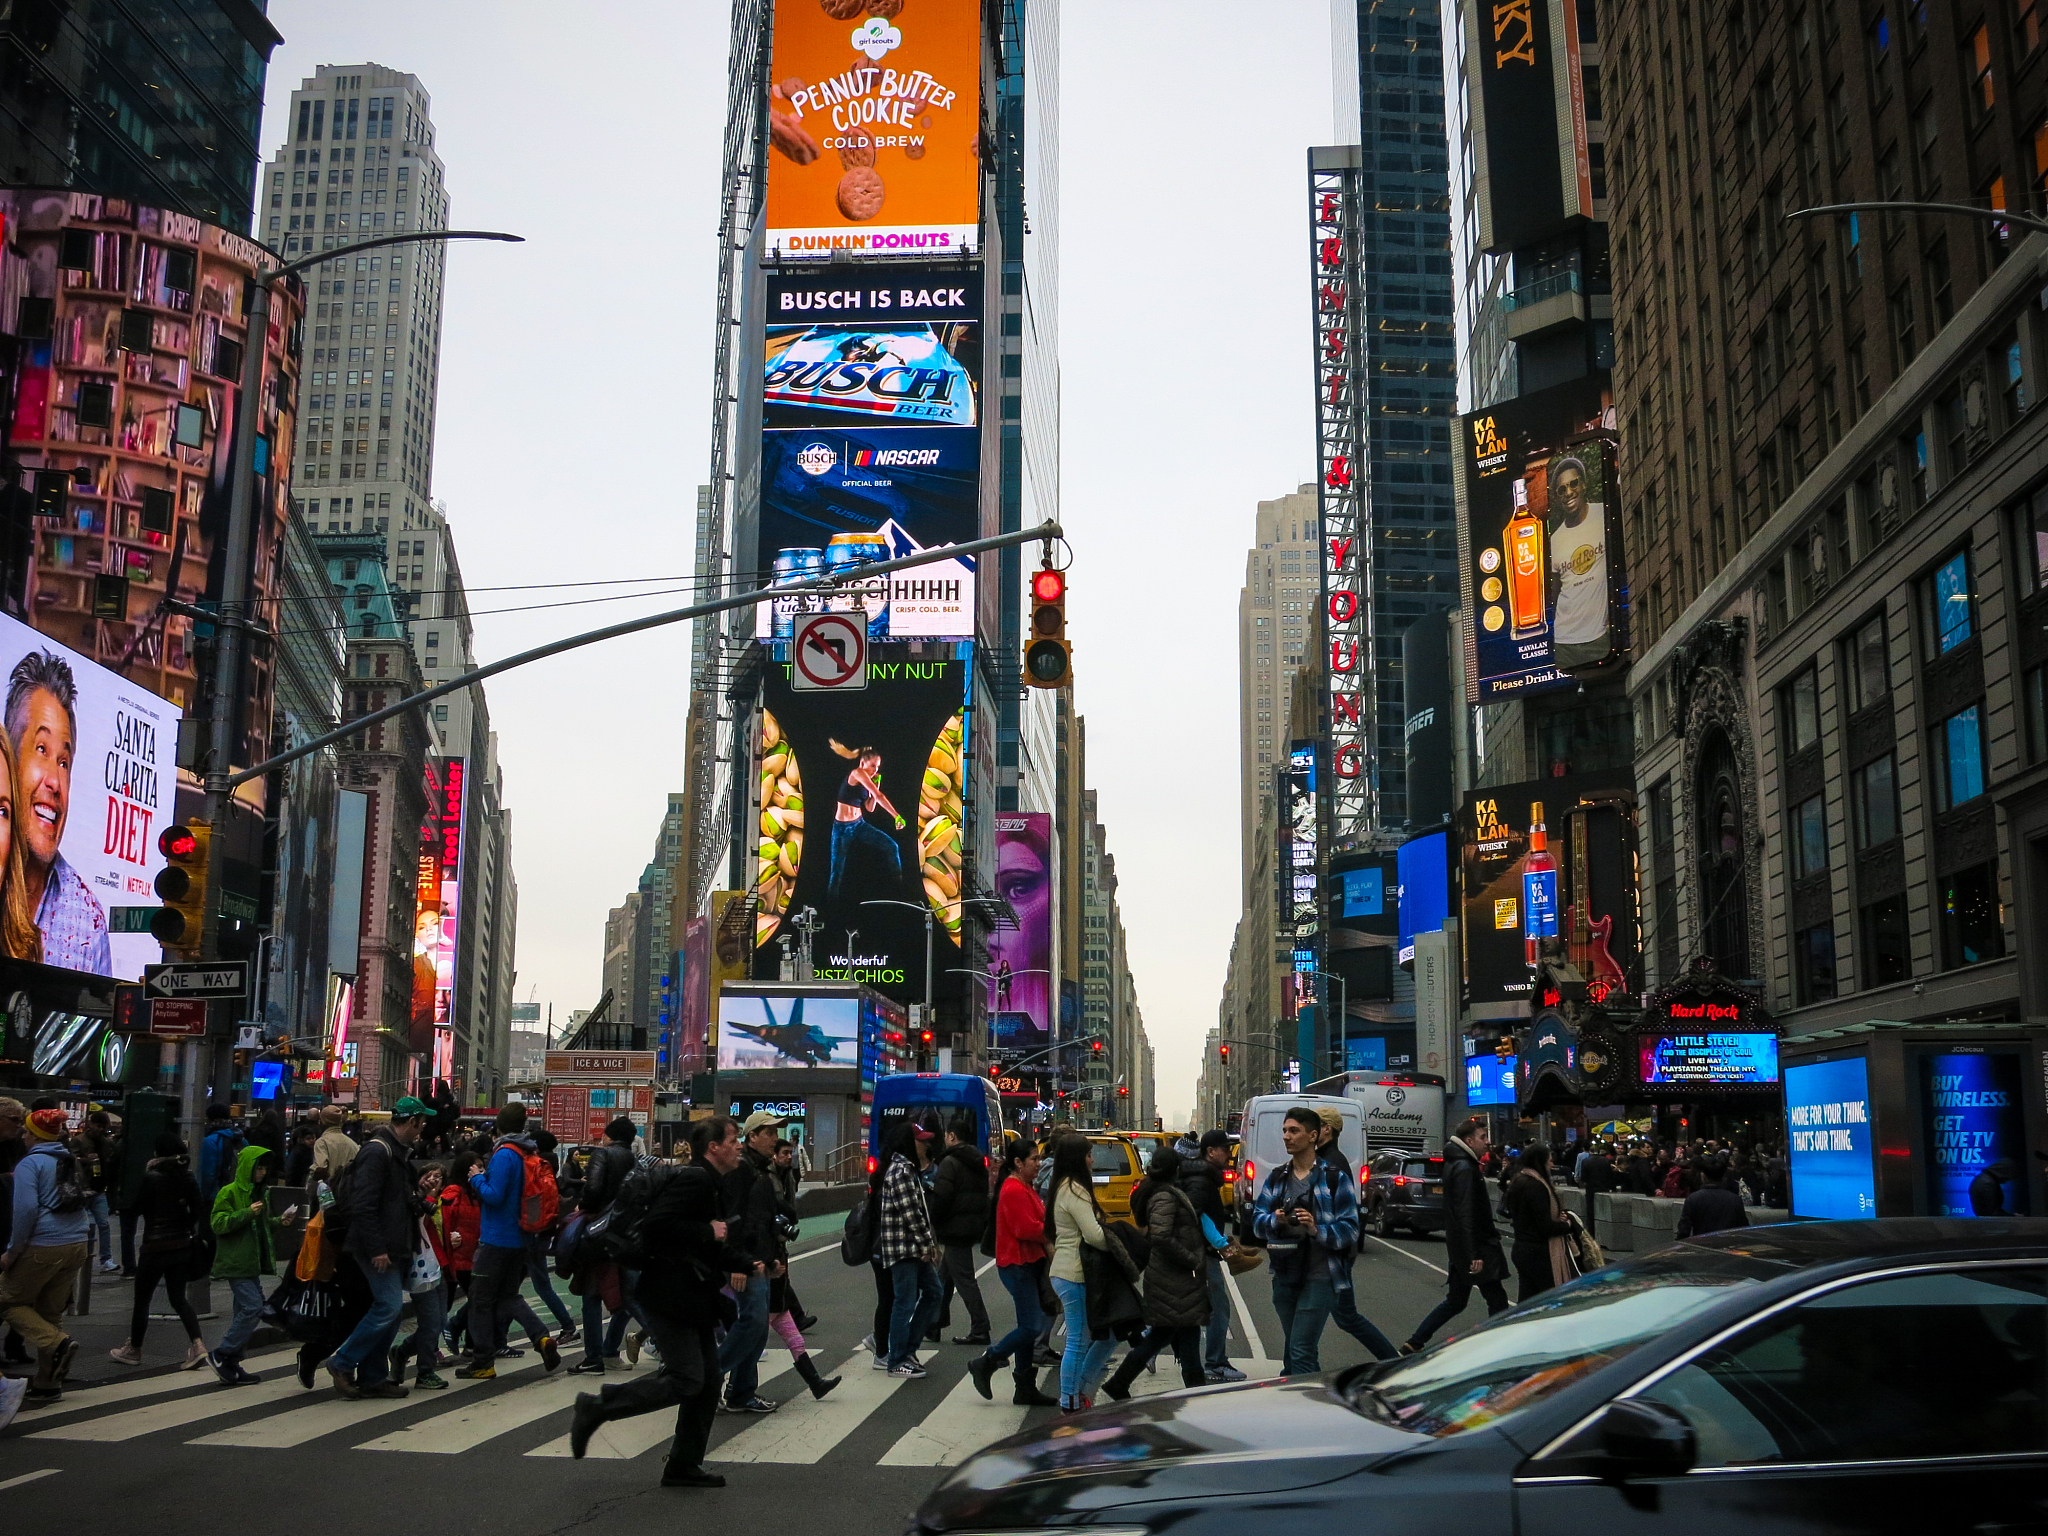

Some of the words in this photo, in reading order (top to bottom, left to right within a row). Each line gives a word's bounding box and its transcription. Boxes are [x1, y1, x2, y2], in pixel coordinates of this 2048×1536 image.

[859, 38, 870, 46] girl
[1571, 54, 1580, 98] REUTERS
[790, 68, 880, 118] PEANUT
[880, 69, 956, 110] BUTTER
[832, 98, 916, 132] COOKIE
[1575, 102, 1584, 151] THOMSON
[823, 136, 869, 149] COLD
[875, 135, 925, 148] BREW
[872, 232, 950, 248] DONUTS
[780, 290, 862, 310] BUSCH
[870, 290, 892, 308] IS
[900, 288, 966, 308] BACK
[1320, 194, 1345, 404] ERNST
[764, 360, 957, 405] BUSCH
[896, 403, 953, 419] BEER
[797, 452, 837, 465] BUSCH
[874, 449, 940, 466] NASCAR
[1476, 454, 1508, 469] WHISKY
[1326, 456, 1351, 486] &
[826, 504, 879, 528] FUSION
[1560, 552, 1582, 574] Hard
[1584, 542, 1606, 559] Rock
[781, 604, 817, 612] LIGT
[1518, 640, 1548, 653] KAVALAN
[1522, 648, 1548, 660] CLASSIC
[1330, 539, 1360, 780] YOUNG
[906, 662, 948, 679] NUT
[1492, 679, 1524, 692] Please
[1525, 670, 1554, 686] Drink
[114, 710, 156, 765] SANTA
[104, 750, 158, 809] CLARITA
[442, 761, 462, 822] Locker
[103, 795, 153, 867] DIET
[442, 826, 459, 866] Foot
[1478, 840, 1509, 852] WHISKY
[109, 870, 120, 880] NOW
[418, 856, 434, 890] STYLE
[94, 875, 120, 890] STREAMING
[126, 878, 152, 898] NETFLIX
[223, 894, 257, 924] Broadway
[130, 910, 144, 930] W
[160, 974, 189, 988] ONE
[203, 972, 234, 987] WAY
[1426, 956, 1435, 998] REUTERS
[155, 1001, 164, 1009] NO
[166, 1002, 194, 1010] STOPPING
[155, 1010, 180, 1018] Anytime
[1670, 1004, 1705, 1018] Hard
[1706, 1004, 1740, 1020] Rock
[1675, 1036, 1704, 1046] LITTLE
[1706, 1036, 1740, 1046] STEVEN
[1590, 1055, 1608, 1066] Rock
[1688, 1048, 1723, 1056] DISCIPLES
[1724, 1048, 1734, 1056] OF
[1735, 1048, 1753, 1056] SOUL
[576, 1059, 590, 1068] ICE
[593, 1059, 600, 1068] &
[603, 1059, 623, 1068] VICE
[1931, 1076, 1963, 1091] BUY
[1932, 1092, 2010, 1108] WIRELESS.
[883, 1108, 905, 1116] 1401
[1368, 1107, 1423, 1125] Academy
[1792, 1106, 1809, 1126] MORE
[1810, 1104, 1822, 1125] FOR
[1823, 1103, 1842, 1124] YOUR
[1842, 1100, 1867, 1123] THING.
[1934, 1115, 1964, 1131] GET
[1792, 1130, 1814, 1151] THAT'S
[1814, 1130, 1828, 1151] OUR
[1829, 1129, 1853, 1151] THING.
[1935, 1132, 1969, 1148] LIVE
[1972, 1132, 1995, 1148] TV
[1936, 1148, 1959, 1164] ON
[1961, 1148, 1985, 1164] US.
[300, 1290, 332, 1318] GAP
